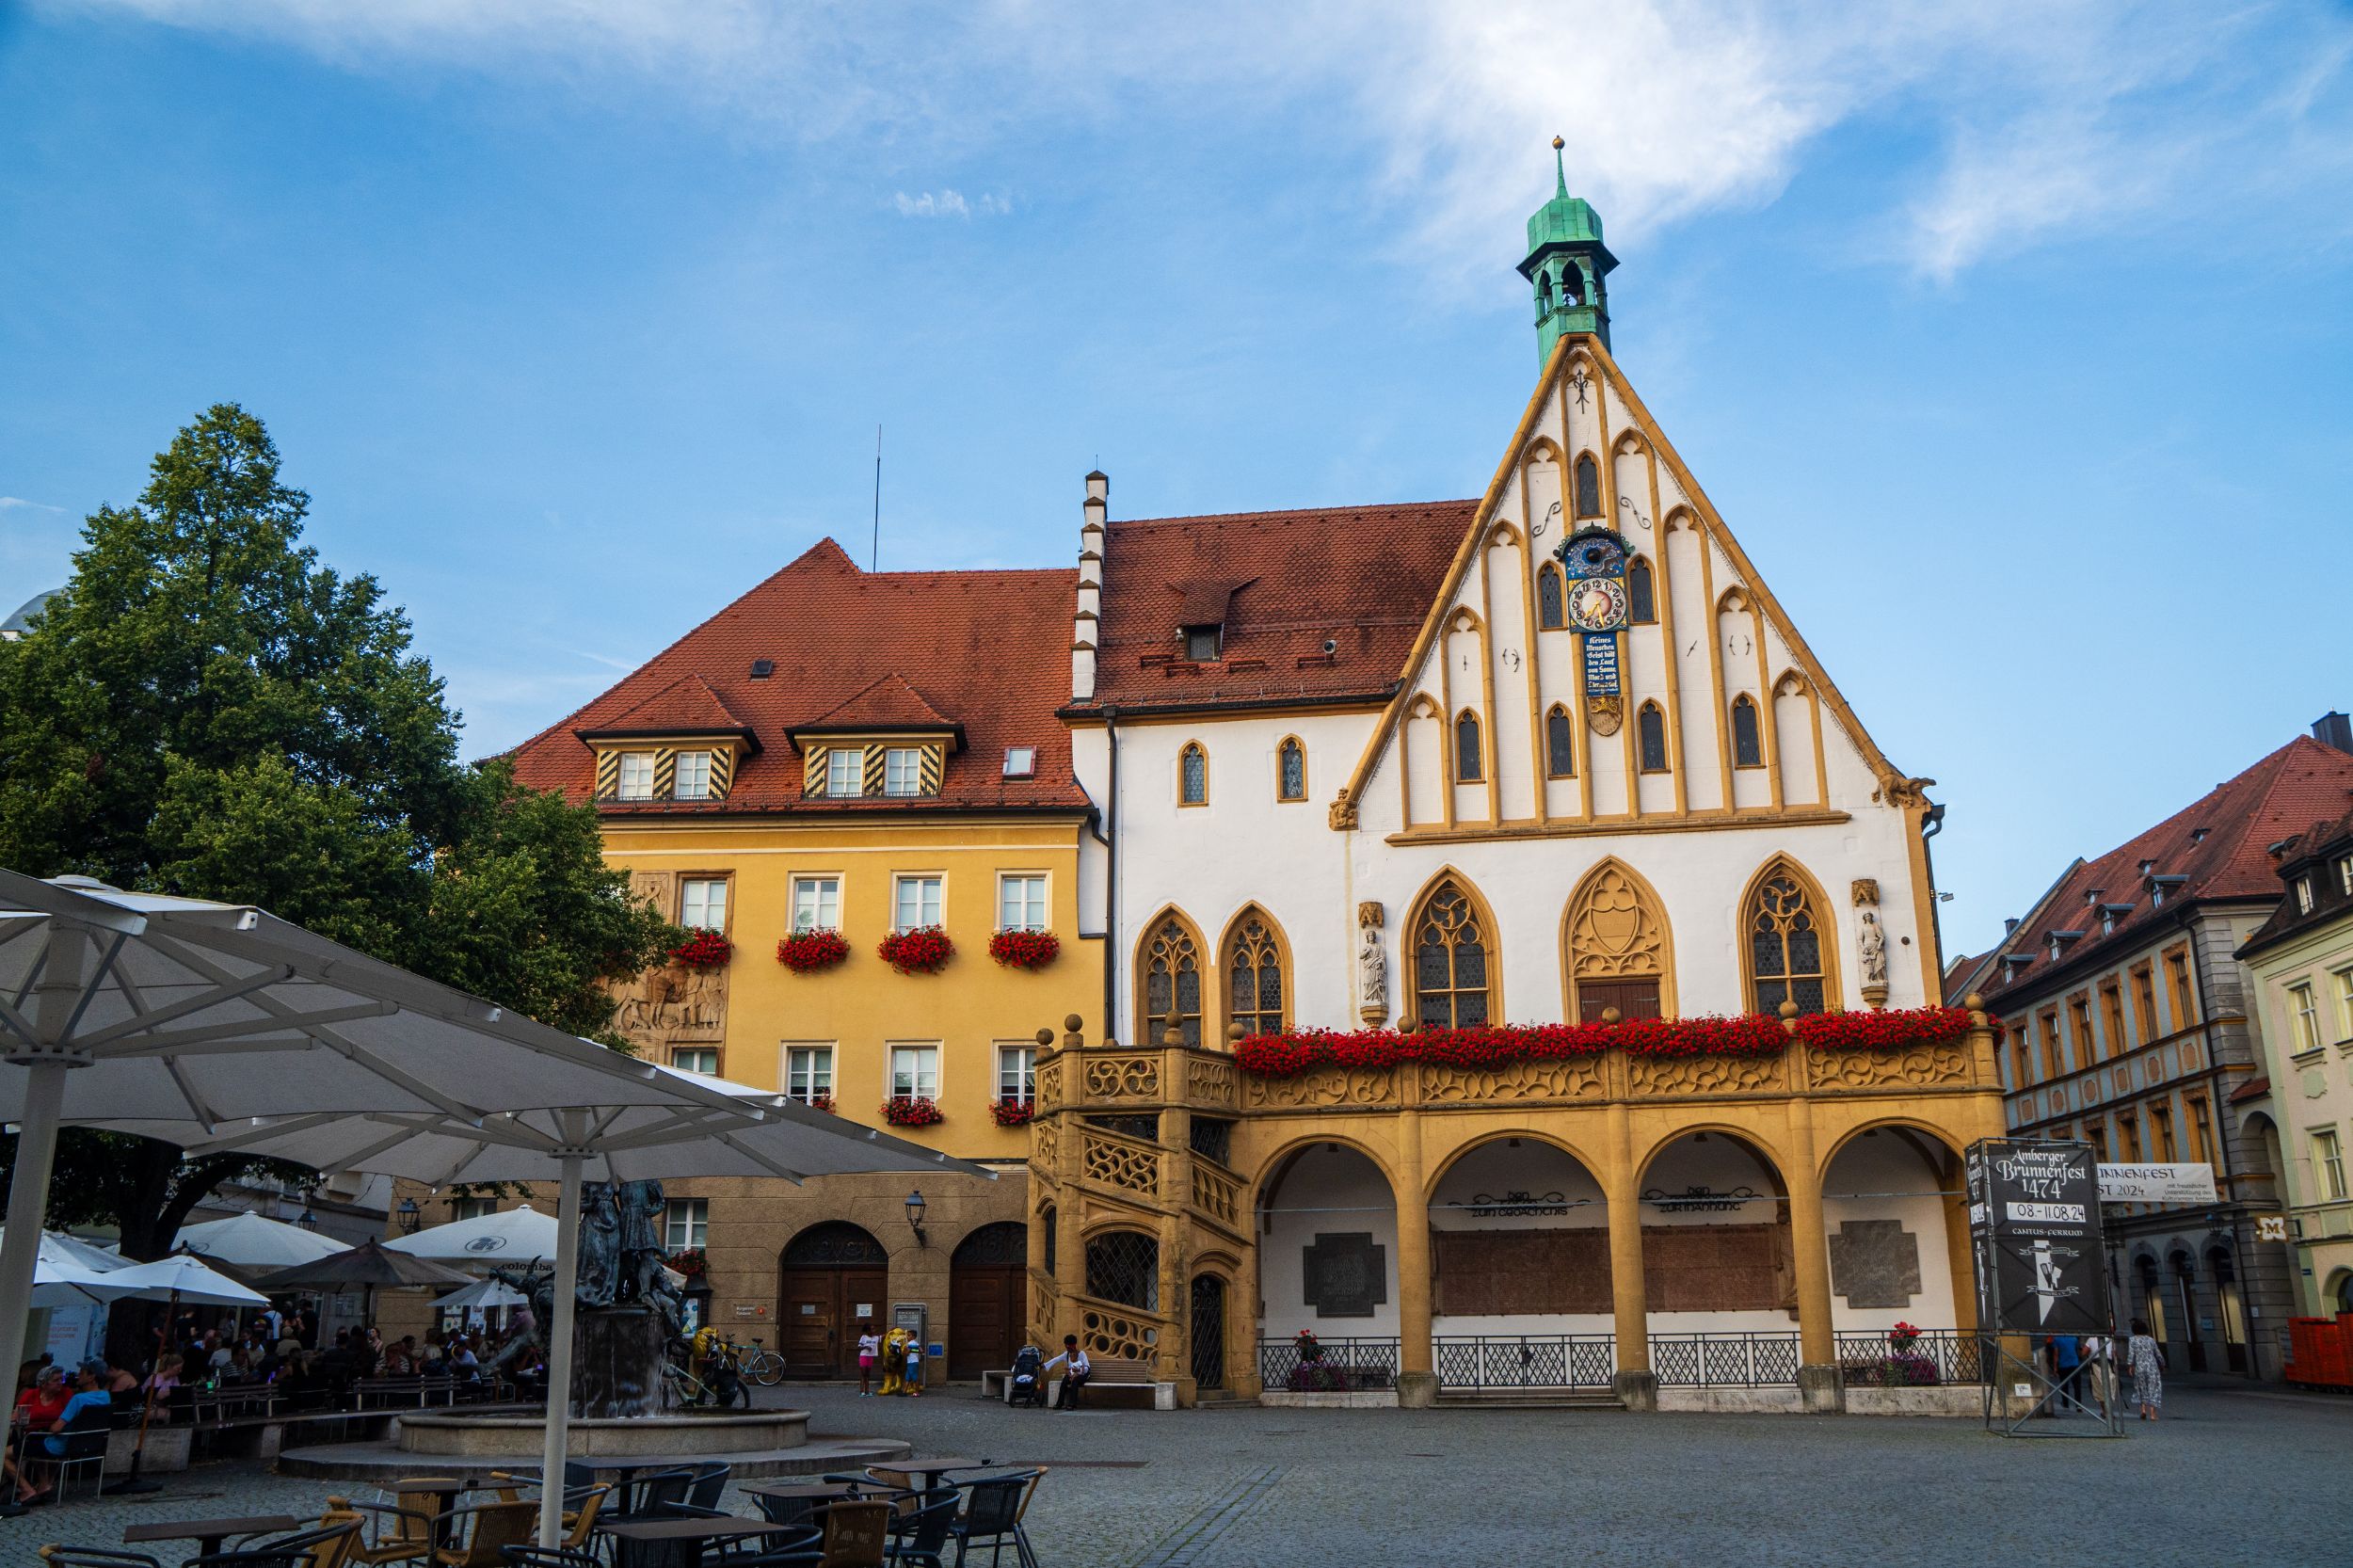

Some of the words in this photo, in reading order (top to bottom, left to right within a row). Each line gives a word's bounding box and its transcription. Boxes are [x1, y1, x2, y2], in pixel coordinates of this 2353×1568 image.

[1593, 579, 1601, 588] 12
[1574, 591, 1583, 600] 10
[1613, 588, 1620, 598] 2
[1573, 600, 1579, 610] 9
[1615, 599, 1624, 608] 3
[1577, 610, 1582, 619] 8
[1607, 616, 1614, 625] 5
[2011, 1148, 2066, 1166] Amberger
[1995, 1160, 2086, 1186] Brunnenfest
[2022, 1178, 2061, 1199] 1474
[2117, 1184, 2145, 1196] 2024
